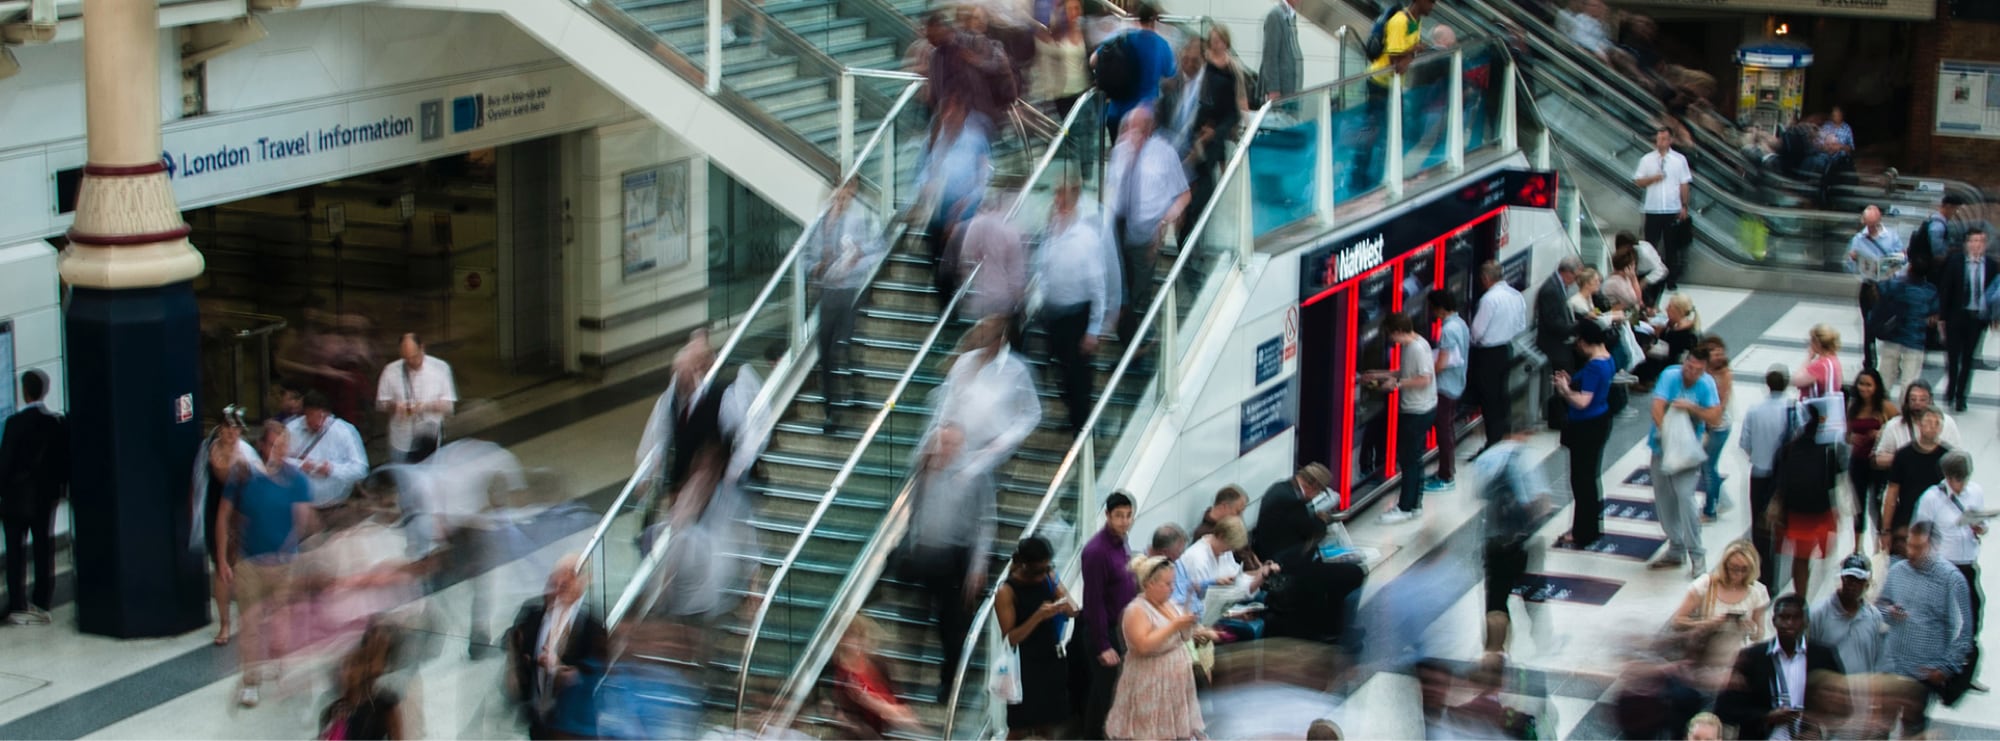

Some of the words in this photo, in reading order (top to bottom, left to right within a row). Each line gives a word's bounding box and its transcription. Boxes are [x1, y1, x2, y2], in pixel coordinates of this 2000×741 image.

[488, 107, 512, 120] Oyster
[513, 103, 529, 115] card
[531, 101, 545, 112] here
[183, 143, 250, 177] London
[257, 131, 311, 160] Travel
[317, 115, 414, 151] Information
[1339, 233, 1384, 282] NatWest
